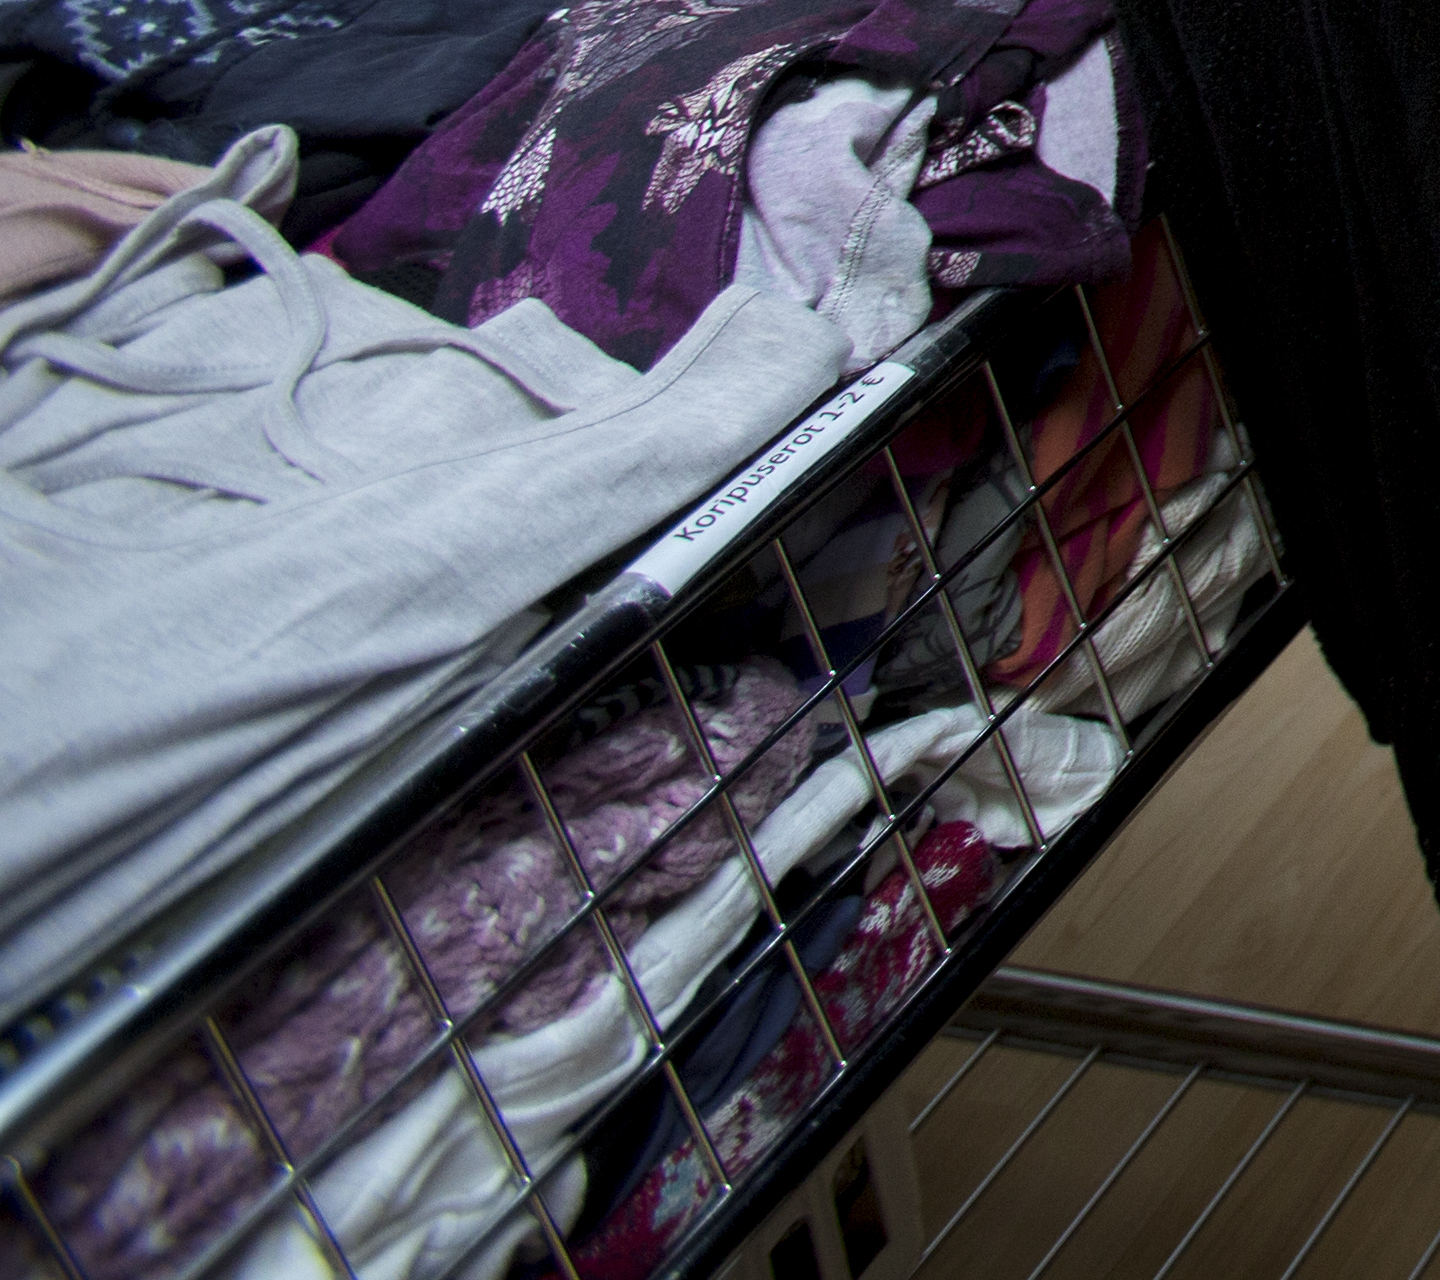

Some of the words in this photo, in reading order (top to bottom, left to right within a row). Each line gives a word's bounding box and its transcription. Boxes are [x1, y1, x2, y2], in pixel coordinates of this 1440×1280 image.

[674, 424, 826, 542] Koripuserot
[819, 390, 866, 422] 1-2
[861, 374, 885, 388] €
